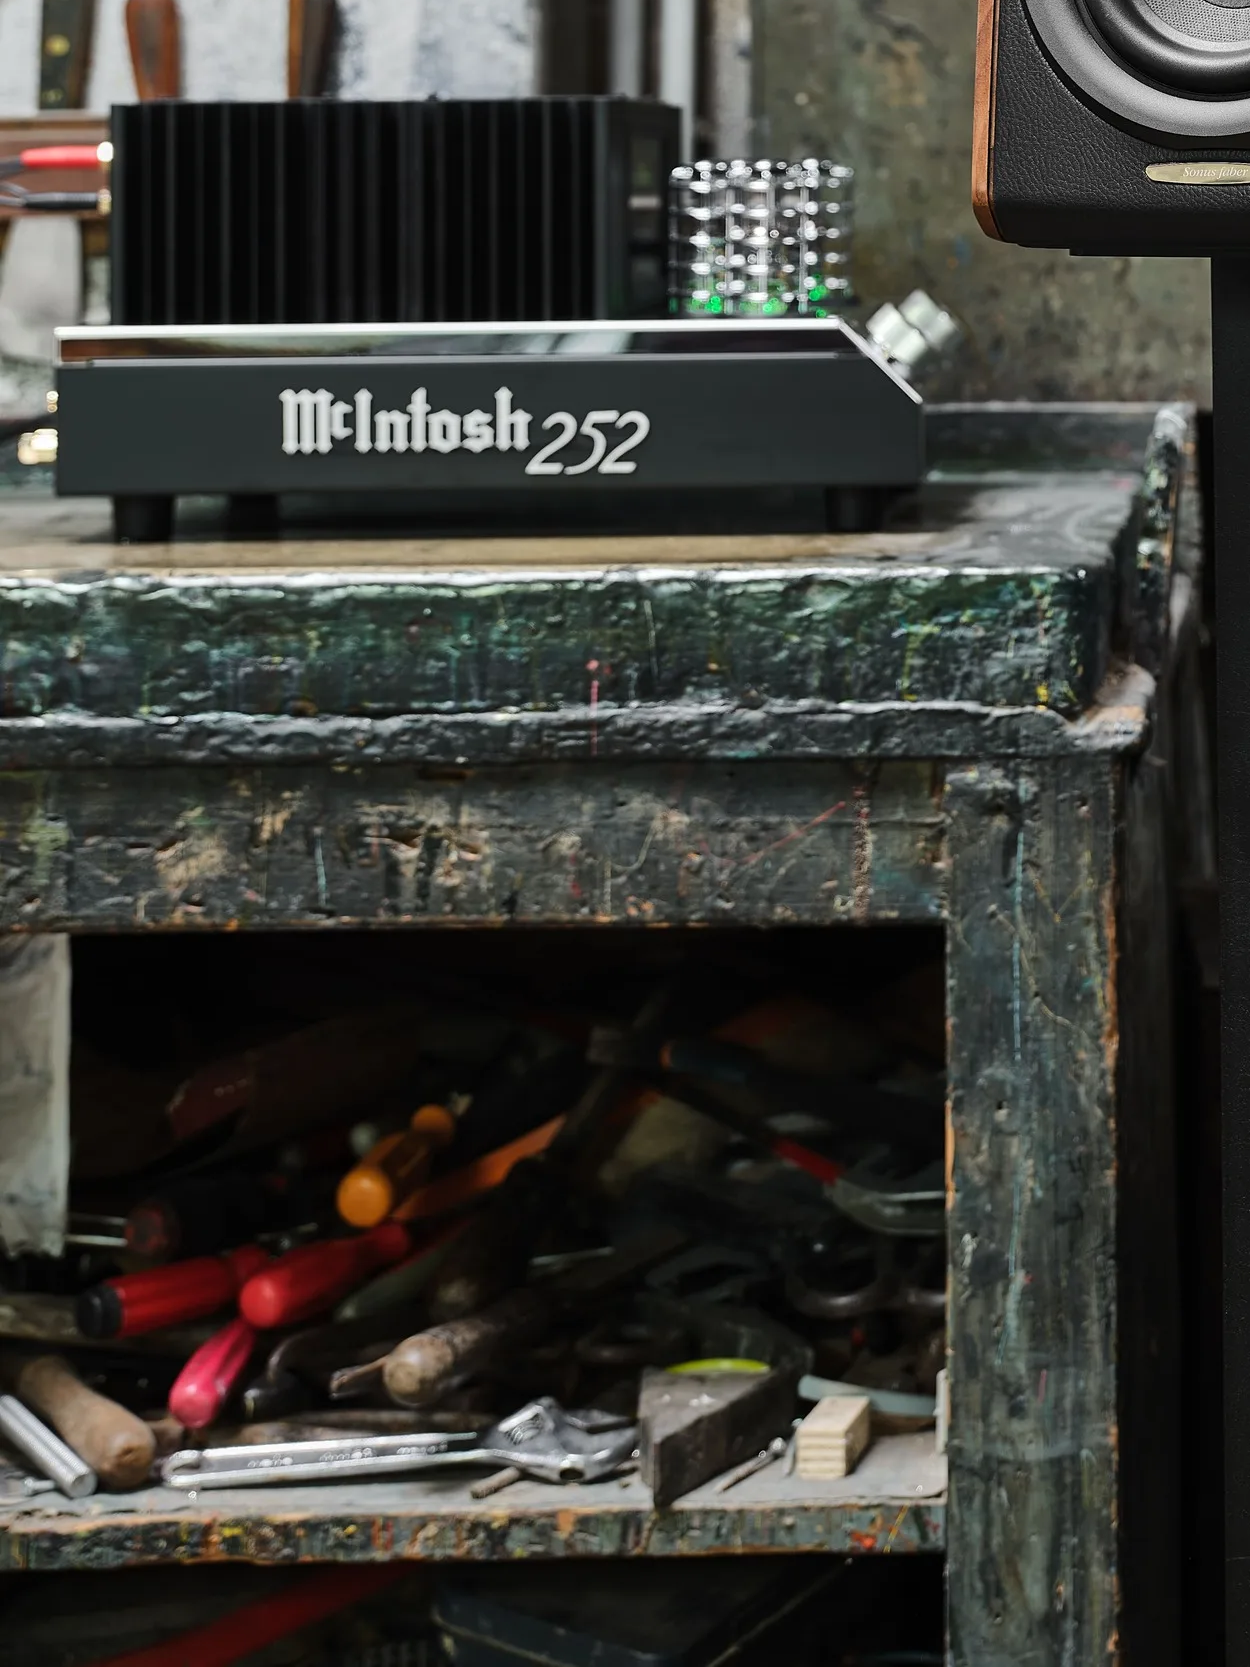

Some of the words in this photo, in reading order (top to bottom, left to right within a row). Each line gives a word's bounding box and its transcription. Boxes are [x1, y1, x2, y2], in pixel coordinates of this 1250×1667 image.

[1183, 166, 1216, 177] Sonus
[1217, 166, 1249, 180] faber
[279, 387, 533, 455] McIntosh
[524, 410, 651, 476] 252
